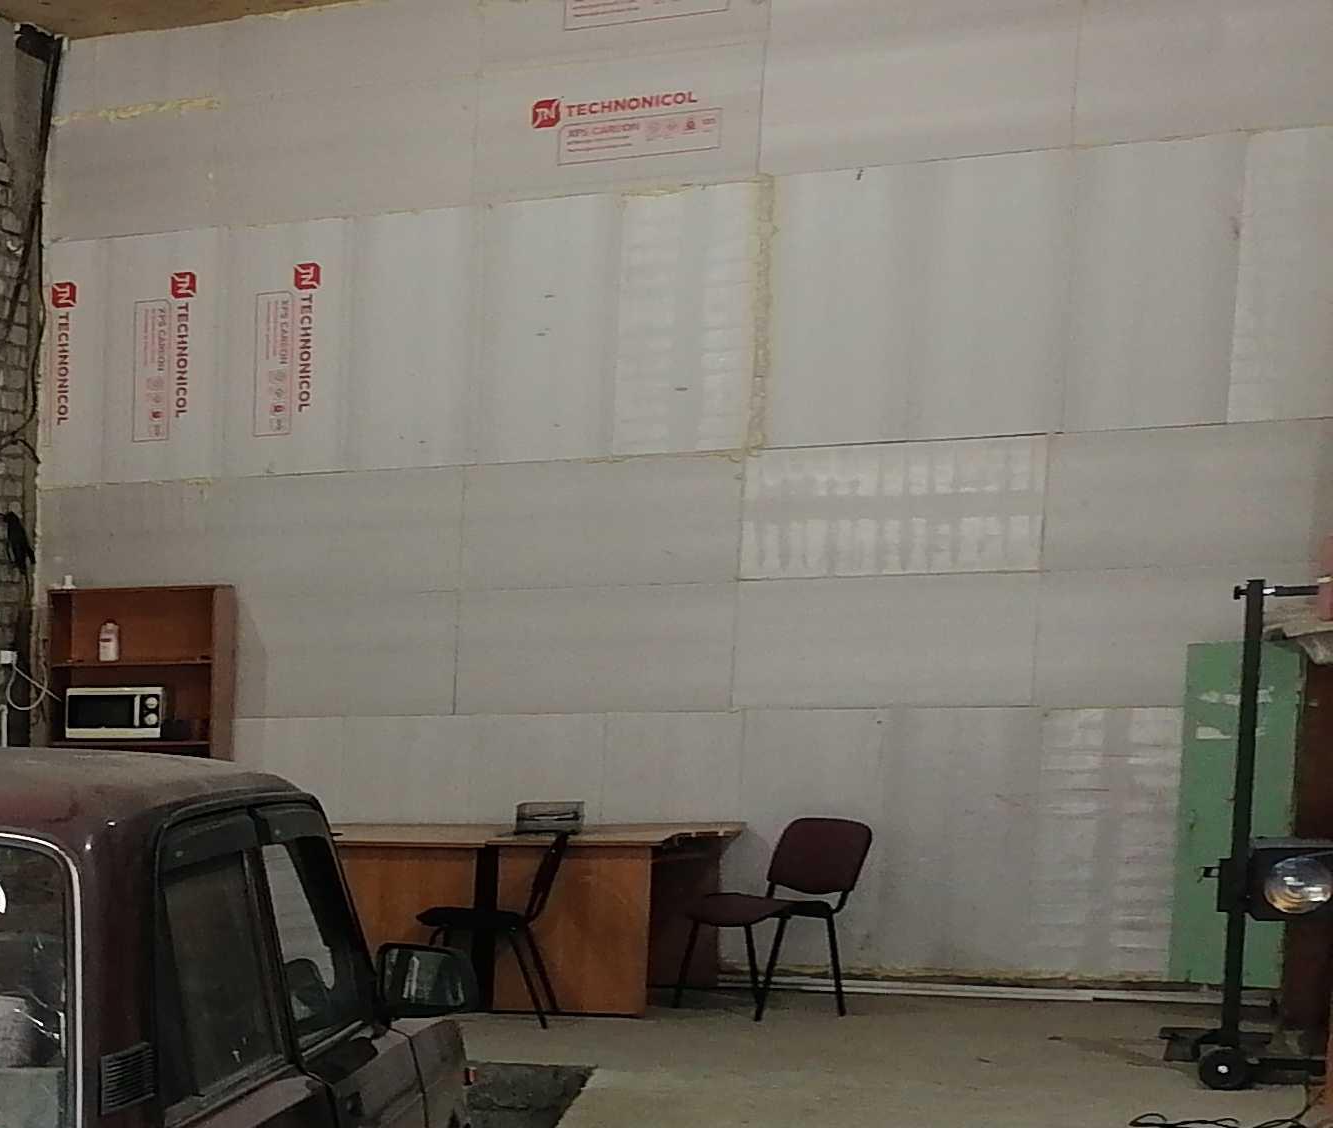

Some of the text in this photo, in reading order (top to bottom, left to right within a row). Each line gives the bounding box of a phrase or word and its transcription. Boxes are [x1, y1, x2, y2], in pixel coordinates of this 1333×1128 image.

[565, 91, 699, 117] TECHNONICOL
[56, 312, 70, 426] TECHNONICOL
[175, 302, 190, 418] TECHNONICOL
[297, 294, 313, 413] TECHNONICOL
